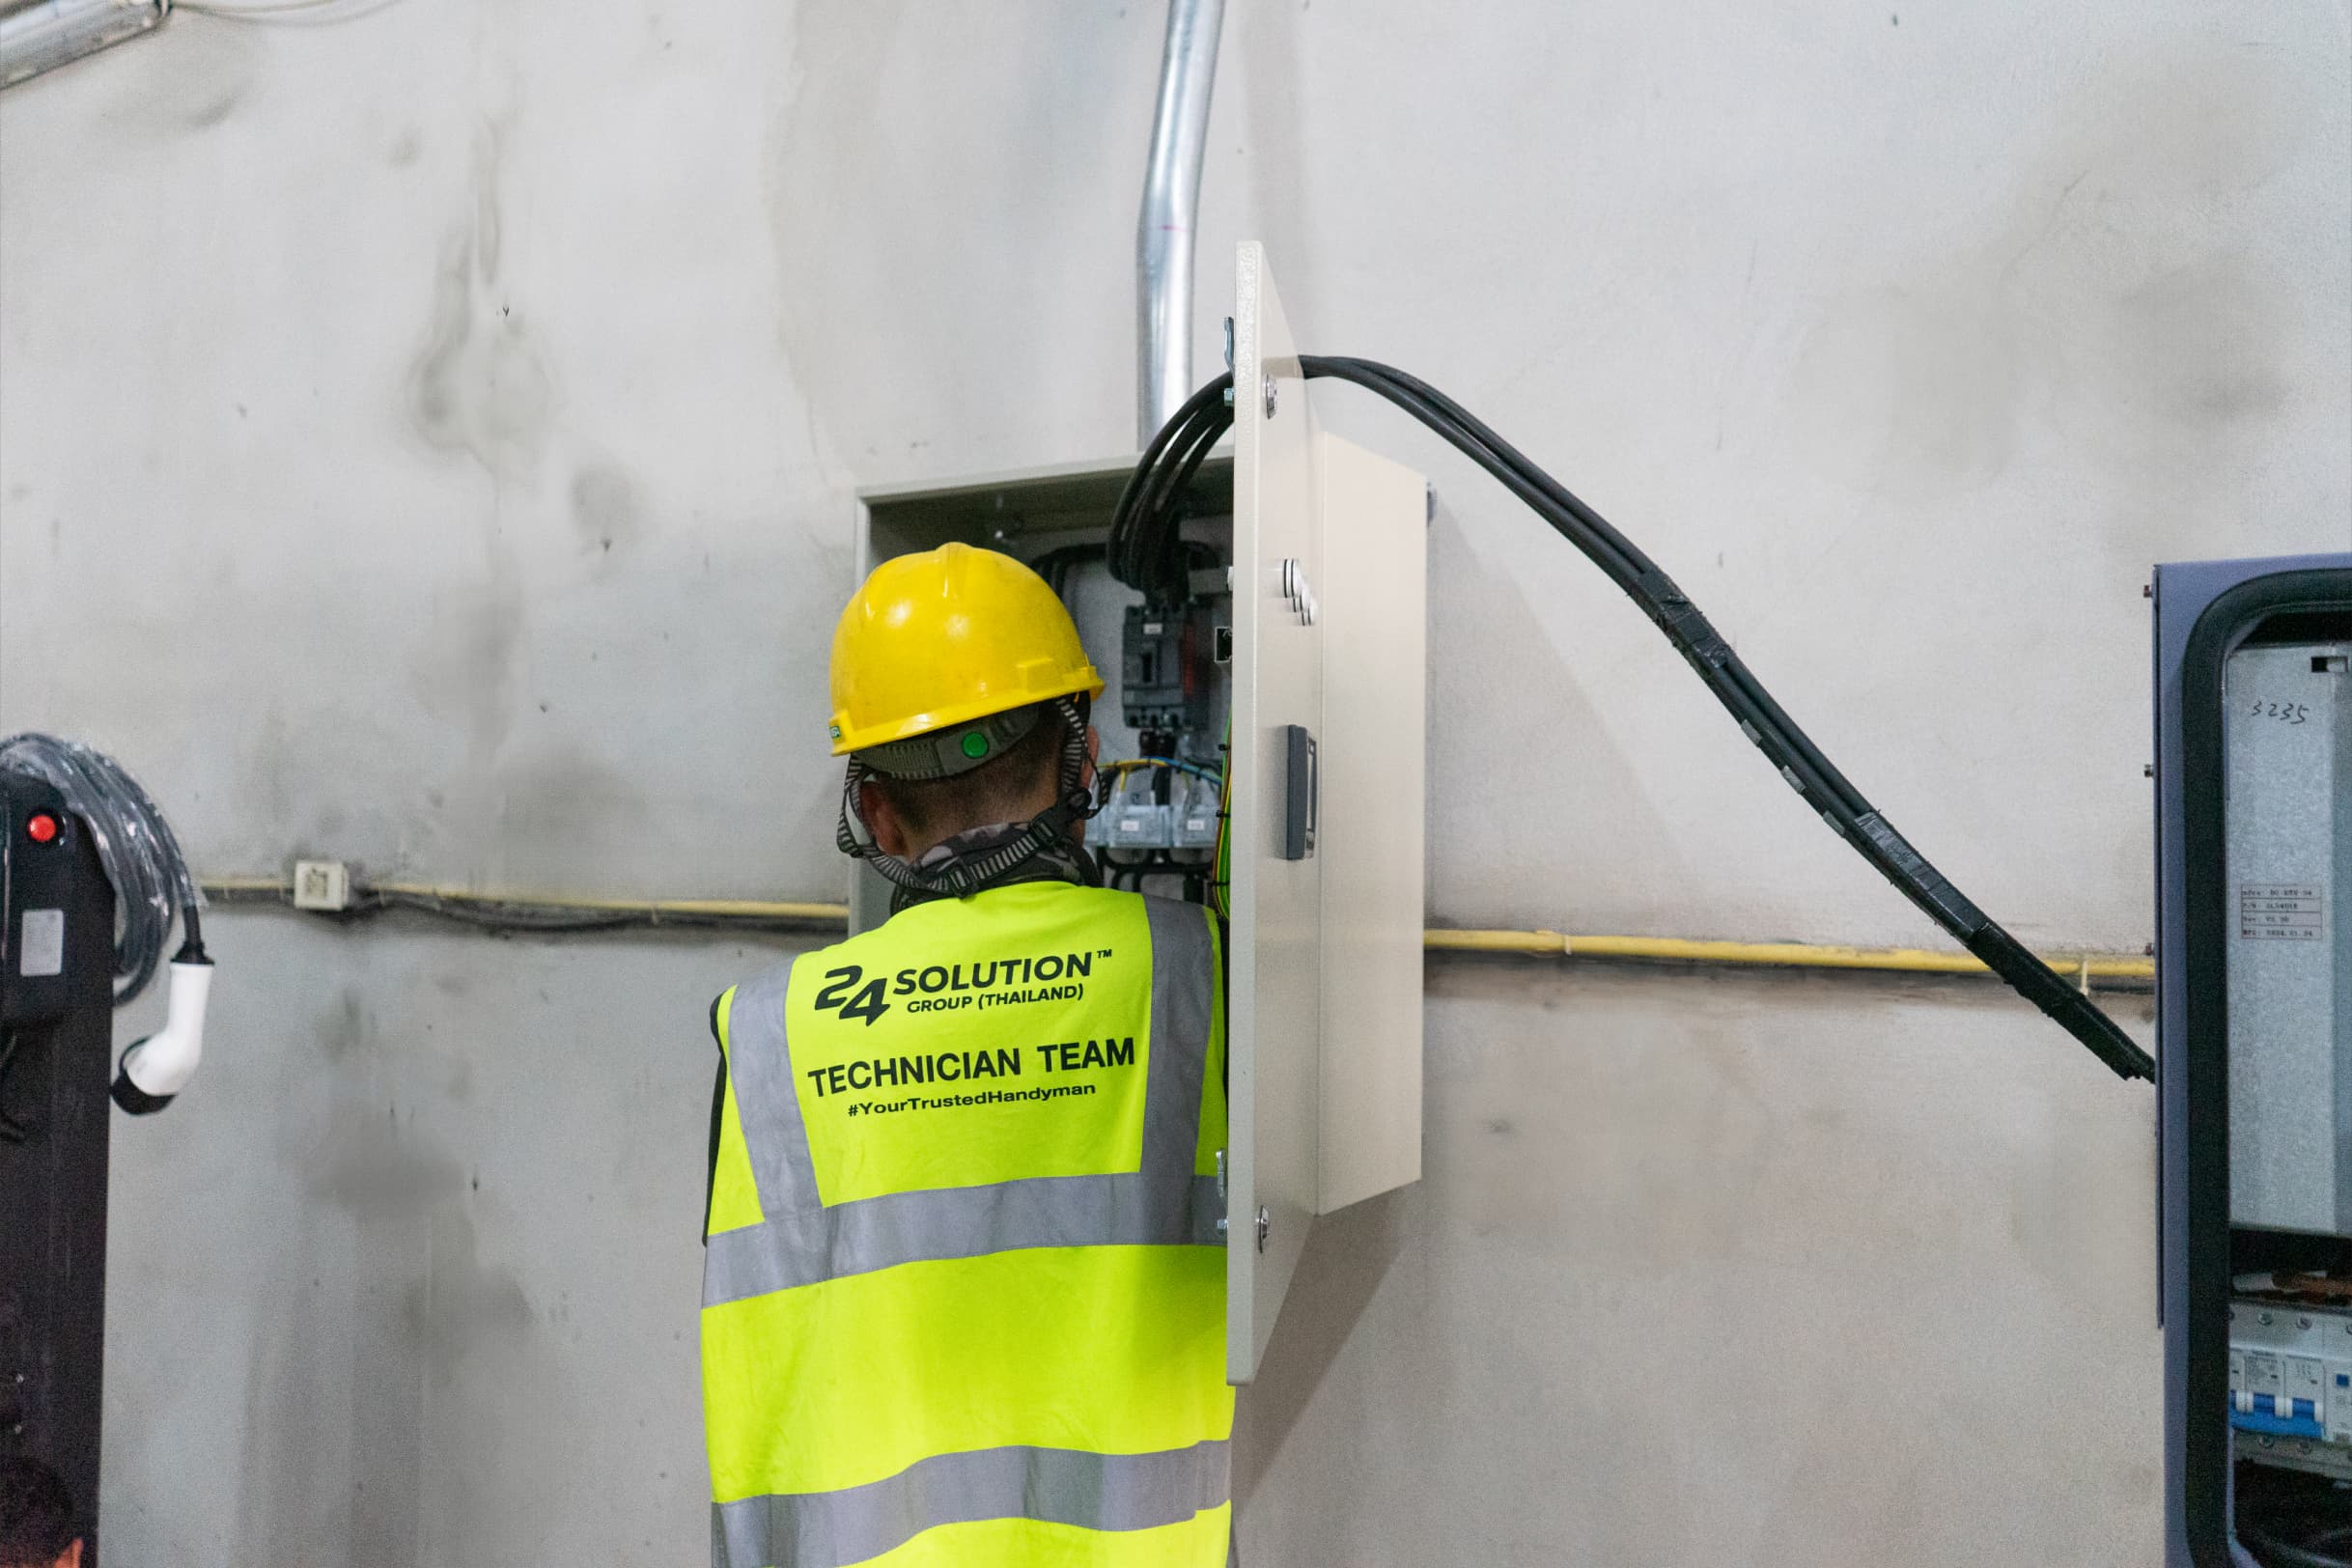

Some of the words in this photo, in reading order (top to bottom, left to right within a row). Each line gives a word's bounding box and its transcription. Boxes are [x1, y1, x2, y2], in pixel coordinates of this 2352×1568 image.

[2251, 701, 2310, 724] 3235
[815, 966, 891, 1026] 24
[893, 952, 1091, 994] SOLUTION
[908, 996, 973, 1013] GROUP
[978, 984, 1084, 1011] (THAILAND)
[808, 1049, 1022, 1097] TECHNICIAN
[1037, 1037, 1134, 1072] TEAM
[848, 1083, 1096, 1117] #YourTrustedHandyman
